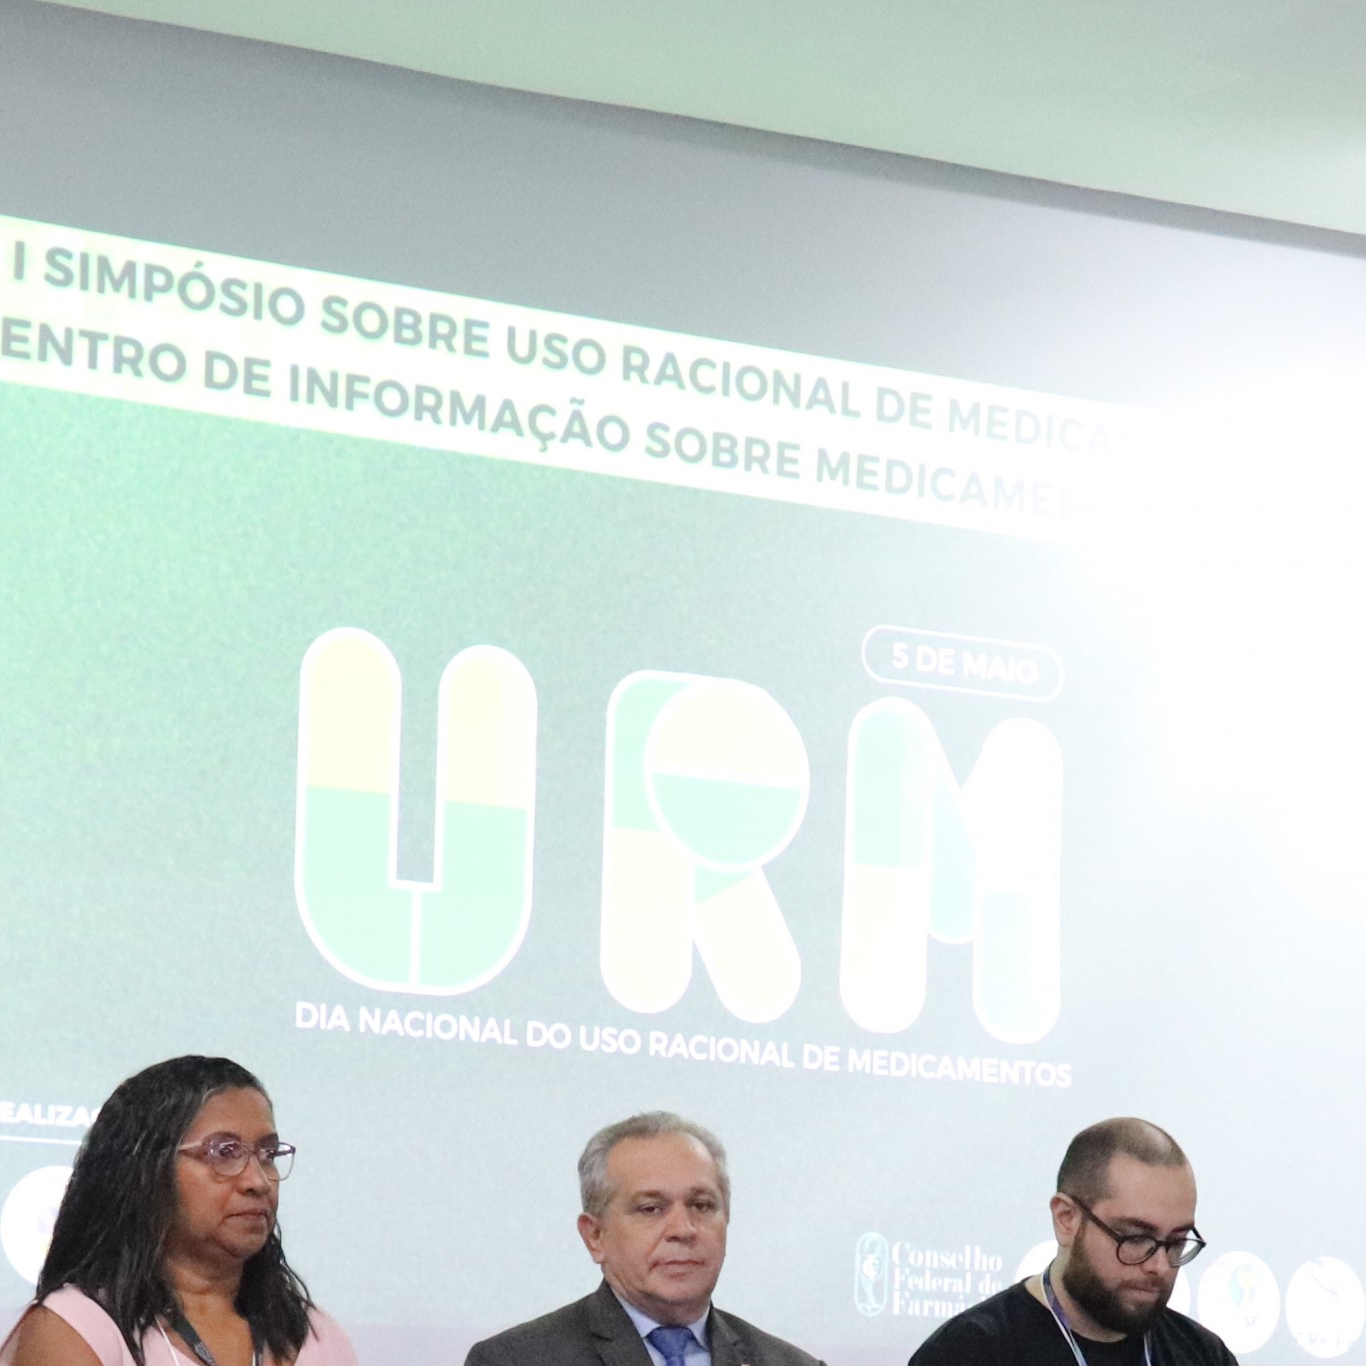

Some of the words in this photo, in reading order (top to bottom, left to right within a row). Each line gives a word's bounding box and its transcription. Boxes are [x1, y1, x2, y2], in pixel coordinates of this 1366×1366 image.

[14, 240, 25, 281] I
[43, 246, 305, 328] SIMPÓSIO
[320, 295, 491, 360] SOBRE
[507, 325, 607, 377] USO
[621, 343, 862, 420] RACIONAL
[875, 386, 934, 431] DE
[203, 350, 272, 398] DE
[288, 364, 631, 454] INFORMAÇÃO
[645, 421, 801, 480] SOBRE
[892, 642, 909, 669] 5
[916, 645, 956, 676] DE
[963, 652, 1040, 685] MAIO
[294, 626, 1065, 1045] URM
[295, 1001, 350, 1032] DIA
[359, 1007, 518, 1046] NACIONAL
[526, 1021, 572, 1050] DO
[579, 1025, 641, 1055] USO
[648, 1031, 796, 1069] RACIONAL
[803, 1044, 841, 1072] DE
[848, 1048, 1073, 1089] MEDICAMENTOS
[892, 1241, 1003, 1271] Conselho
[894, 1267, 972, 1294] Federal
[893, 1290, 967, 1318] Farmá
